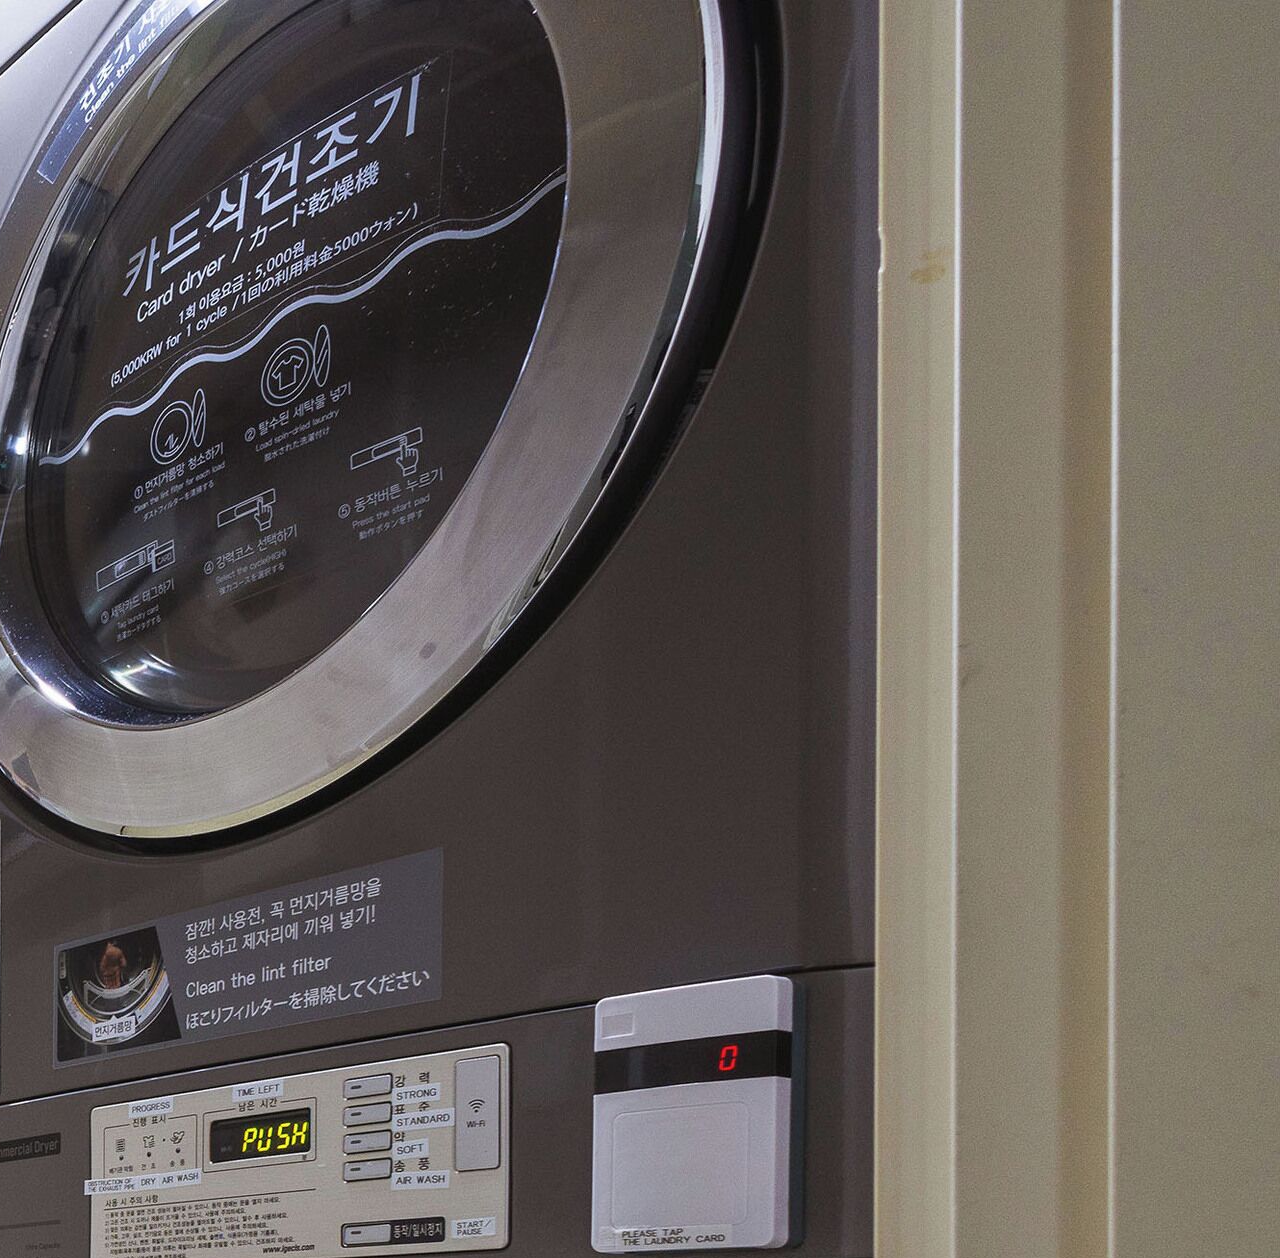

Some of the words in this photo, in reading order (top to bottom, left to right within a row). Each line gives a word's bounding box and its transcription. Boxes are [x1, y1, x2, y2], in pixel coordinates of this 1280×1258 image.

[84, 82, 114, 124] Clean
[116, 54, 136, 79] the
[122, 73, 422, 297] 카드식건조기
[199, 277, 244, 310] 이용요금
[254, 239, 307, 282] 5,000원
[137, 284, 173, 323] Card
[179, 254, 227, 294] dryer
[110, 341, 163, 388] (5,000KRW
[165, 331, 183, 351] for
[186, 323, 193, 338] 1
[196, 305, 228, 333] cycle
[293, 393, 327, 419] 세탁물
[187, 442, 225, 472] 청소하기
[354, 483, 402, 513] 동작버튼
[405, 467, 444, 494] 누르기
[257, 523, 298, 552] 선택하기
[184, 919, 216, 943] 잠깐!
[218, 906, 267, 935] 사용전,
[269, 901, 286, 920] 꼭
[288, 876, 383, 918] 먼지거름망을
[184, 940, 239, 966] 청소하고
[241, 922, 301, 953] 제자리에
[304, 914, 335, 941] 끼워
[339, 902, 378, 932] 넣기!
[185, 976, 227, 1000] Clean
[229, 971, 256, 989] the
[261, 964, 287, 983] lint
[290, 954, 333, 978] filter
[93, 1018, 133, 1039] 먼지거름망
[236, 1087, 258, 1098] TIME
[258, 1083, 281, 1096] LEFT
[396, 1087, 438, 1101] STRONG
[131, 1100, 172, 1115] PROGRESS
[396, 1113, 451, 1127] STANDARD
[34, 1139, 59, 1155] Dryer
[241, 1120, 310, 1154] PUSH
[396, 1143, 425, 1156] SOFT
[140, 1175, 157, 1187] DRY
[161, 1174, 175, 1185] AIR
[176, 1172, 200, 1184] WASH
[395, 1175, 412, 1186] AIR
[416, 1174, 447, 1184] WASH
[456, 1228, 483, 1236] PAUSE
[621, 1228, 658, 1239] PLEASE
[662, 1227, 685, 1237] TAP
[622, 1237, 641, 1247] THE
[643, 1235, 691, 1246] LAUNDRY
[695, 1232, 726, 1244] CARD
